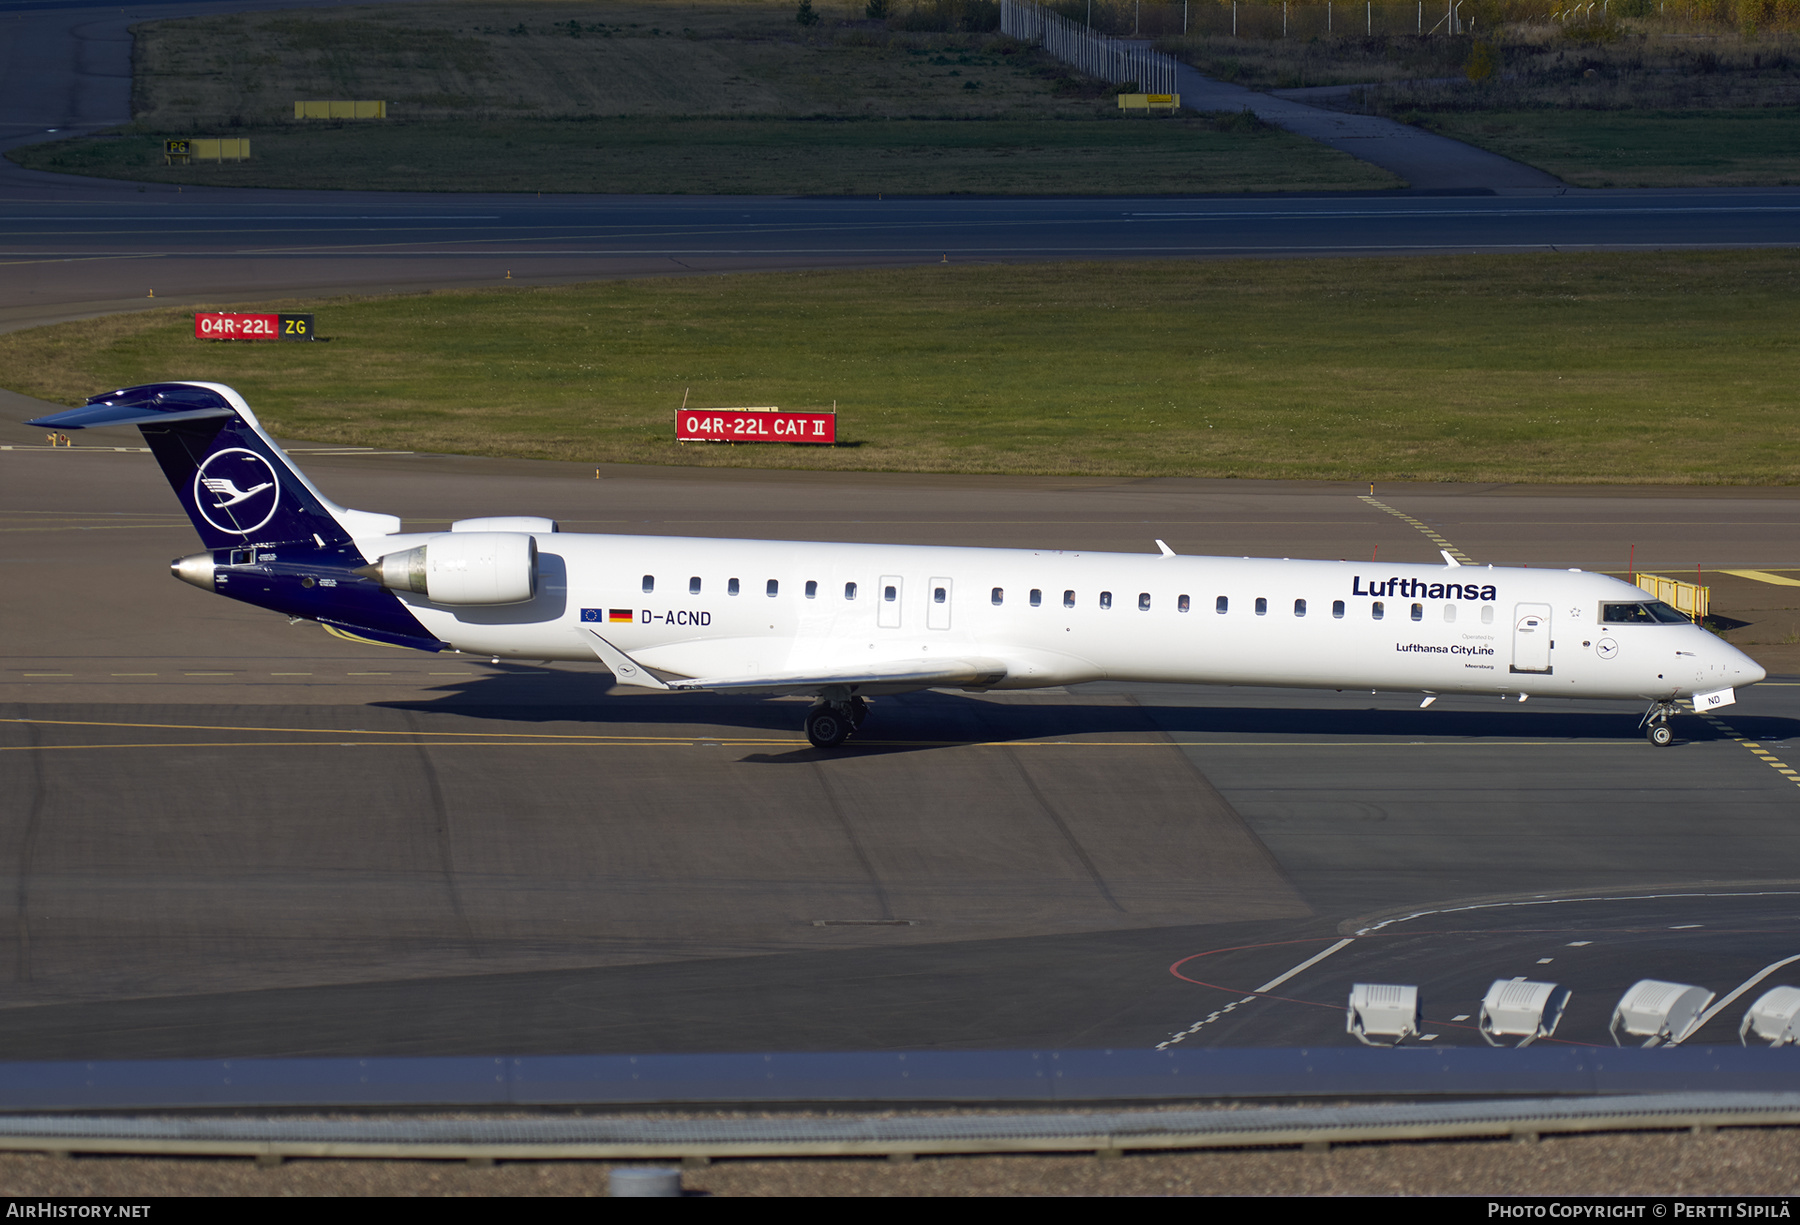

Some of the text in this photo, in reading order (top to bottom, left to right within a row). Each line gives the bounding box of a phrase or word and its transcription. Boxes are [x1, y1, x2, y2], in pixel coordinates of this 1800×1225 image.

[170, 142, 186, 153] PG
[201, 319, 274, 334] 04R-22L
[285, 320, 306, 335] ZG
[686, 417, 769, 435] 04R-22L
[773, 419, 808, 435] CAT
[1352, 575, 1497, 601] Lufthansa
[642, 609, 712, 626] D-ACND
[1396, 643, 1495, 656] Lufthansa CityLine
[1708, 695, 1721, 705] ND
